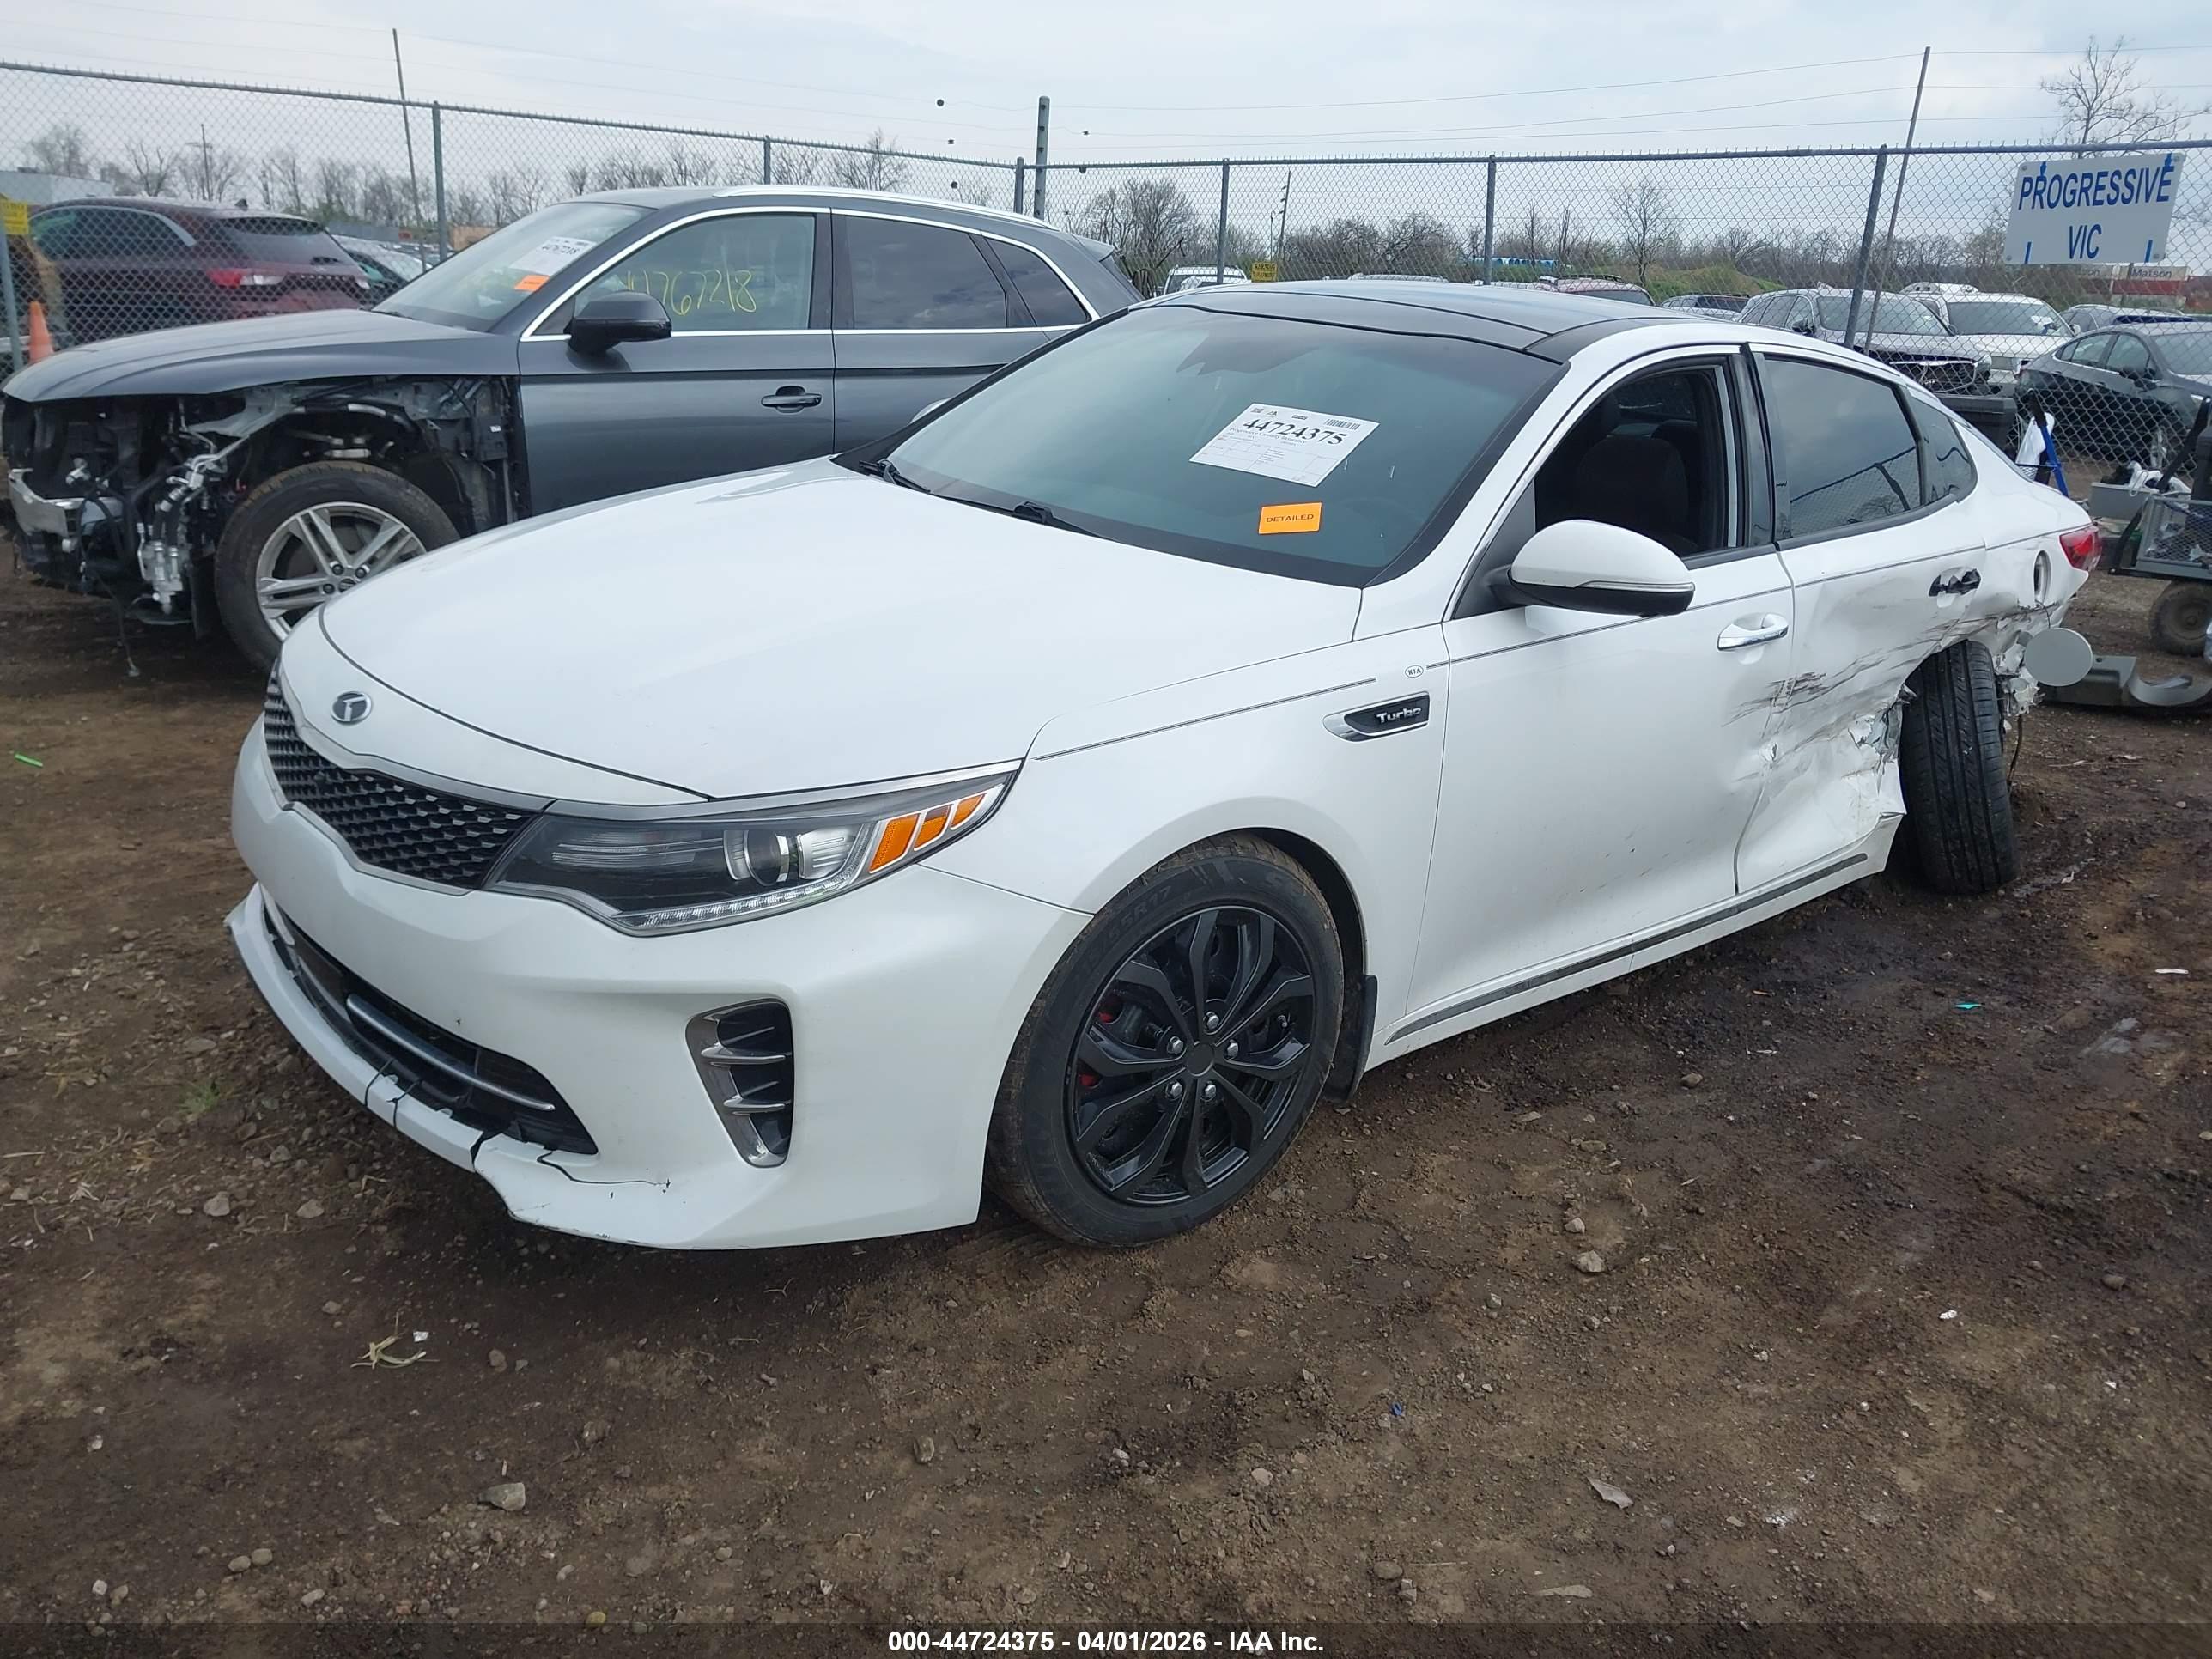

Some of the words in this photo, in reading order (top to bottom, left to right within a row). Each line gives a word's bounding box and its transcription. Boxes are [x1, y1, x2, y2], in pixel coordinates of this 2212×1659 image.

[2018, 166, 2175, 210] PROGRESSIVE
[2069, 224, 2102, 259] VIC
[2131, 268, 2172, 278] Matson
[1243, 419, 1348, 445] 44724375
[1266, 513, 1315, 523] DETAILED
[1377, 708, 1422, 723] Turbo
